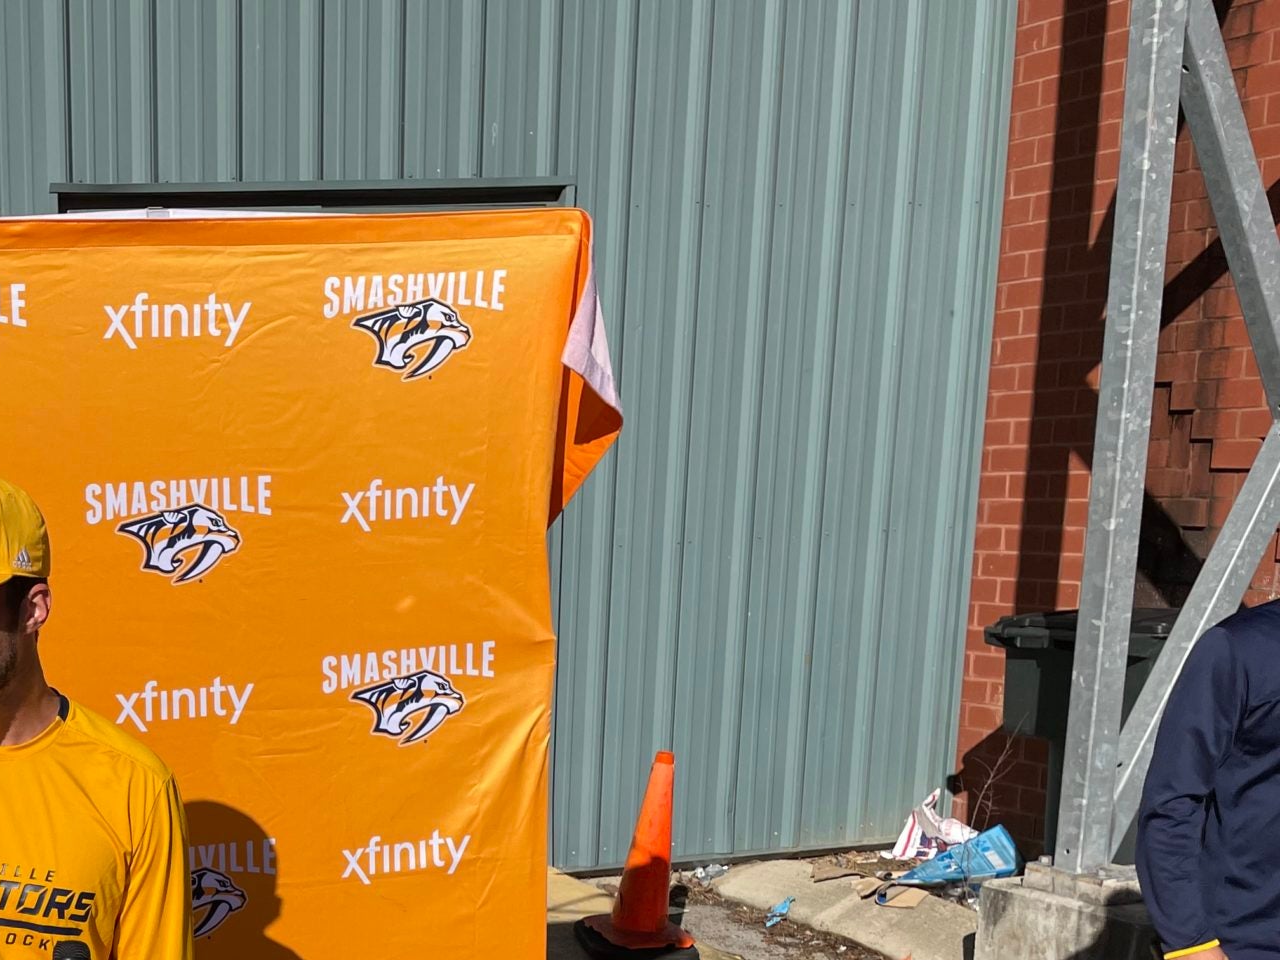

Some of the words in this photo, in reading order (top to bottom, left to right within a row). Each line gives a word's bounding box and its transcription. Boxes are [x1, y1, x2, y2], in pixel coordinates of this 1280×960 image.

[103, 291, 253, 350] xfinity
[322, 268, 509, 319] SMASHVILLE
[84, 474, 272, 525] SMASHVILLE
[340, 475, 476, 533] xfinity
[321, 640, 496, 694] SMASHVILLE
[115, 676, 254, 733] xfinity
[188, 838, 277, 875] VILLE
[341, 829, 471, 885] xfinity
